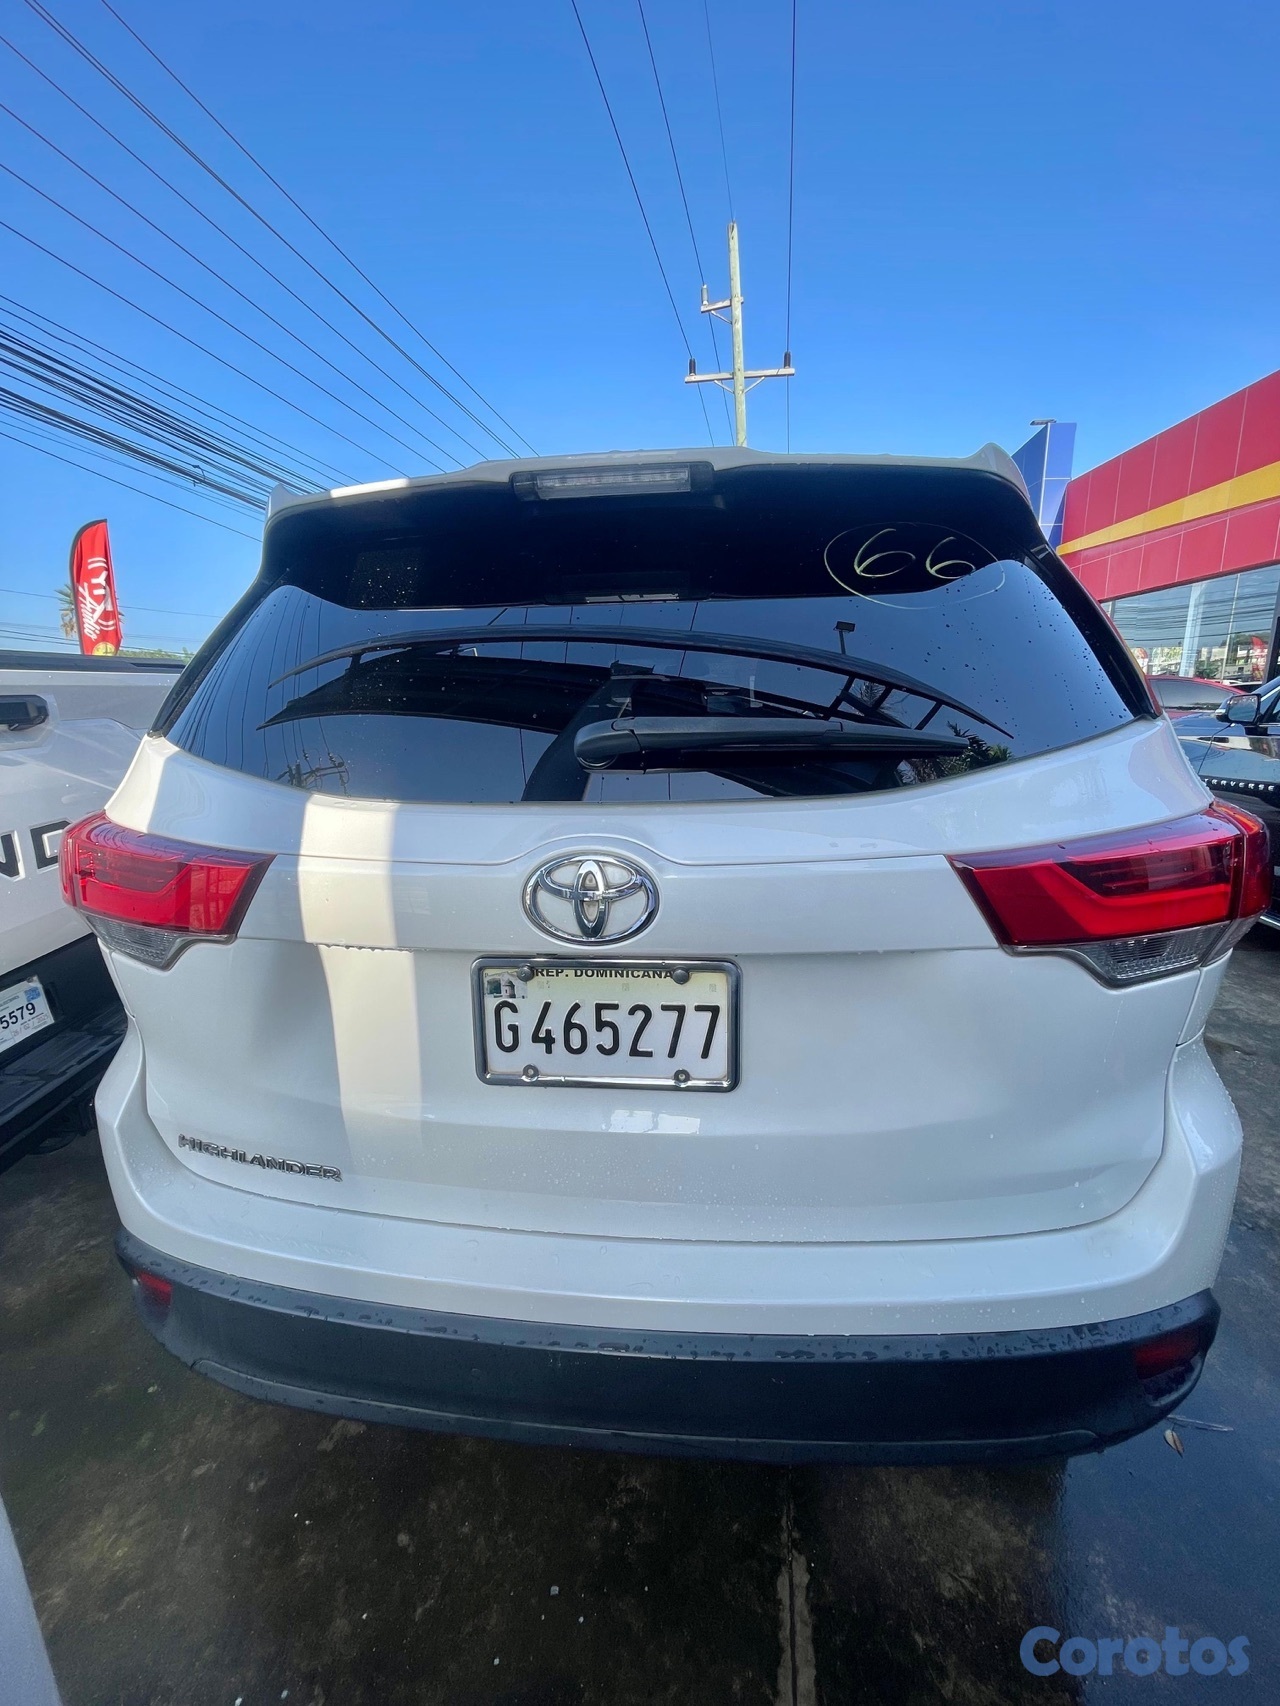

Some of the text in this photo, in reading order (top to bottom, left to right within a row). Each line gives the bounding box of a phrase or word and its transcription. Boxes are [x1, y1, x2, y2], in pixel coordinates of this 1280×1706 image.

[853, 527, 977, 580] 66
[79, 581, 101, 641] Audio
[1203, 778, 1275, 792] TRAVERSE
[534, 967, 673, 980] REP. DOMINICANA
[0, 1002, 36, 1030] 5579
[494, 1000, 721, 1060] G465277
[178, 1133, 344, 1183] HIGHLANDER
